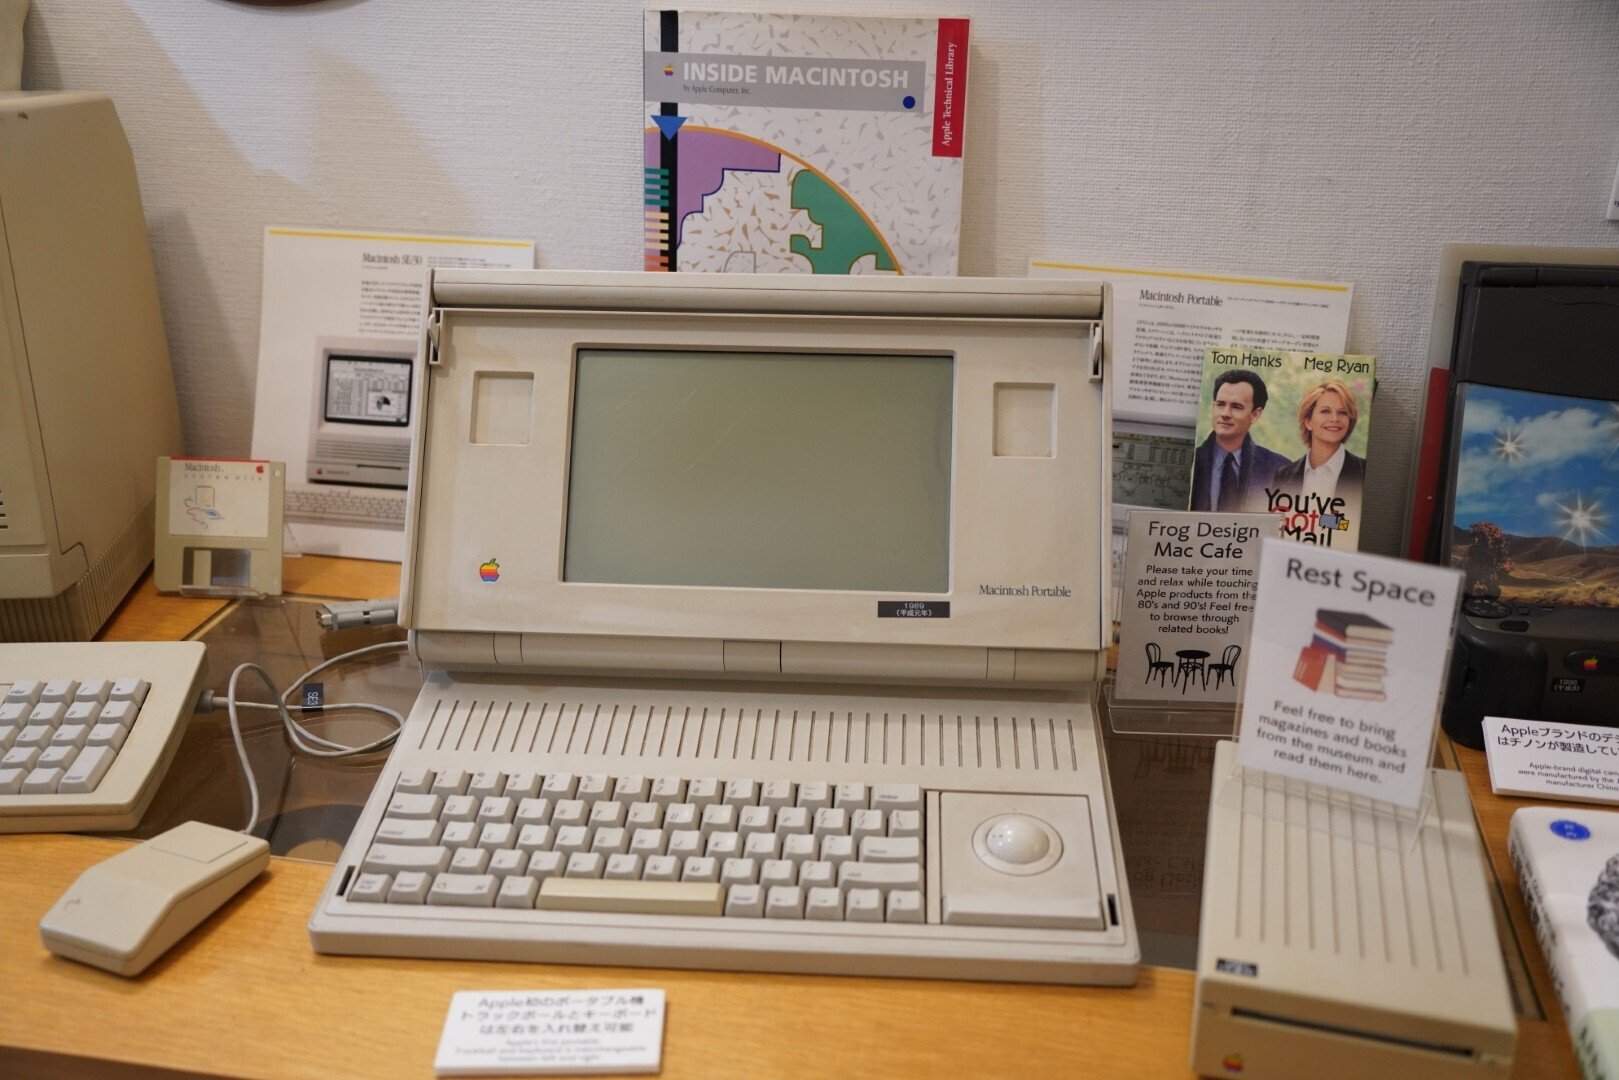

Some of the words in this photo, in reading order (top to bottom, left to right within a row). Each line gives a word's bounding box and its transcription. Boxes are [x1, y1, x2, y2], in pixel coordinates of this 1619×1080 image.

[945, 42, 957, 76] Library
[683, 62, 758, 83] INSIDE
[765, 66, 909, 89] MACINTOSH
[683, 84, 691, 92] by
[691, 85, 709, 94] Apple
[942, 77, 954, 119] Technical
[941, 120, 953, 147] Apple
[362, 253, 400, 265] Macintosh
[1139, 289, 1184, 303] Macintosh
[1187, 293, 1223, 307] Portable
[1211, 351, 1238, 365] Tom
[1242, 353, 1282, 368] Hanks
[1304, 356, 1333, 373] Meg
[1337, 358, 1369, 375] Ryan
[185, 463, 221, 472] Macintosh
[1264, 488, 1345, 514] You've
[1148, 521, 1190, 542] Frog
[1196, 522, 1260, 543] Design
[1154, 541, 1194, 558] Mac
[1200, 542, 1243, 559] Cafe
[1146, 565, 1178, 575] Please
[1181, 566, 1203, 575] take
[1206, 568, 1228, 577] your
[1231, 566, 1253, 576] time
[979, 584, 1029, 596] Macintosh
[1031, 585, 1072, 597] Portable
[1137, 577, 1156, 586] and
[1159, 577, 1184, 587] relax
[1187, 578, 1213, 587] while
[1216, 579, 1258, 592] touching
[1286, 557, 1342, 589] Rest
[1352, 570, 1436, 607] Space
[1136, 588, 1166, 599] Apple
[1169, 589, 1213, 600] products
[1216, 590, 1239, 599] from
[1242, 590, 1257, 600] the
[1137, 600, 1158, 609] 80's
[1161, 600, 1180, 610] and
[1183, 601, 1207, 610] 90's!
[1209, 602, 1231, 611] Feel
[1150, 612, 1160, 621] to
[1163, 612, 1198, 621] browse
[1201, 613, 1240, 625] through
[1158, 624, 1193, 633] related
[1196, 625, 1229, 634] books!
[1273, 700, 1303, 716] Feel
[1307, 707, 1335, 725] free
[1339, 715, 1354, 728] to
[1358, 719, 1396, 742] bring
[1259, 715, 1329, 740] magazines
[1333, 732, 1359, 747] and
[1364, 738, 1407, 759] books
[1256, 727, 1287, 744] from
[1291, 736, 1313, 751] the
[1317, 745, 1374, 766] museum
[1378, 758, 1405, 774] and
[1273, 748, 1304, 764] read
[1308, 756, 1343, 774] them
[1347, 765, 1382, 785] here.
[1529, 762, 1576, 773] Apple-brand
[1578, 765, 1602, 775] digital
[1537, 771, 1588, 781] manufactured
